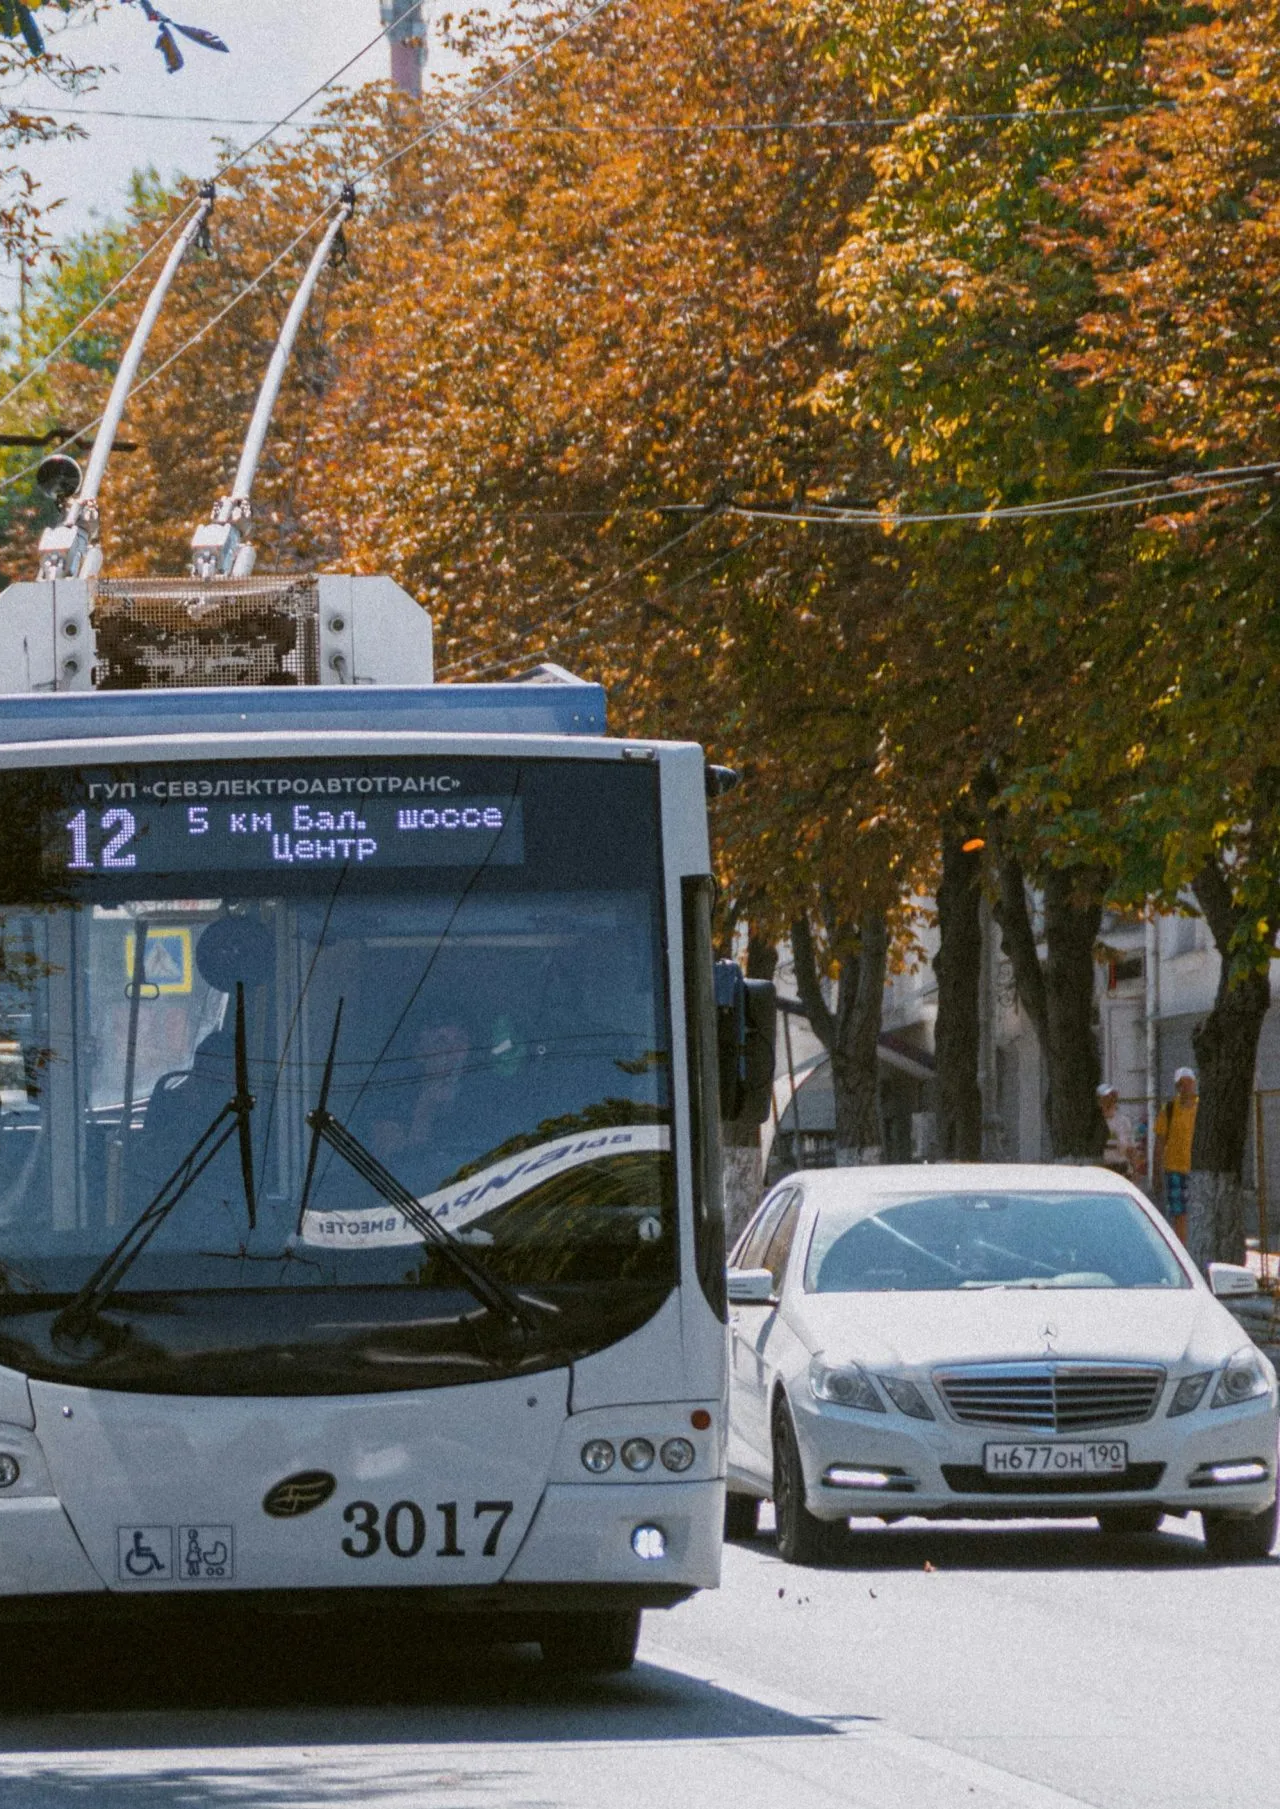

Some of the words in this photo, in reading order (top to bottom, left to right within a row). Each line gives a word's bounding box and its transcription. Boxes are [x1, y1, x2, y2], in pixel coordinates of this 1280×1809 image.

[88, 782, 136, 799] ГУП
[142, 775, 461, 798] «СЕВЭЛЕКТРОАВТОТРАНС»
[187, 806, 209, 834] 5
[229, 812, 272, 832] км
[292, 804, 367, 831] Бал.
[398, 806, 503, 830] шоссе
[66, 808, 136, 867] 12
[272, 832, 378, 862] Центр
[1088, 1445, 1121, 1462] 190
[341, 1500, 514, 1558] 3017
